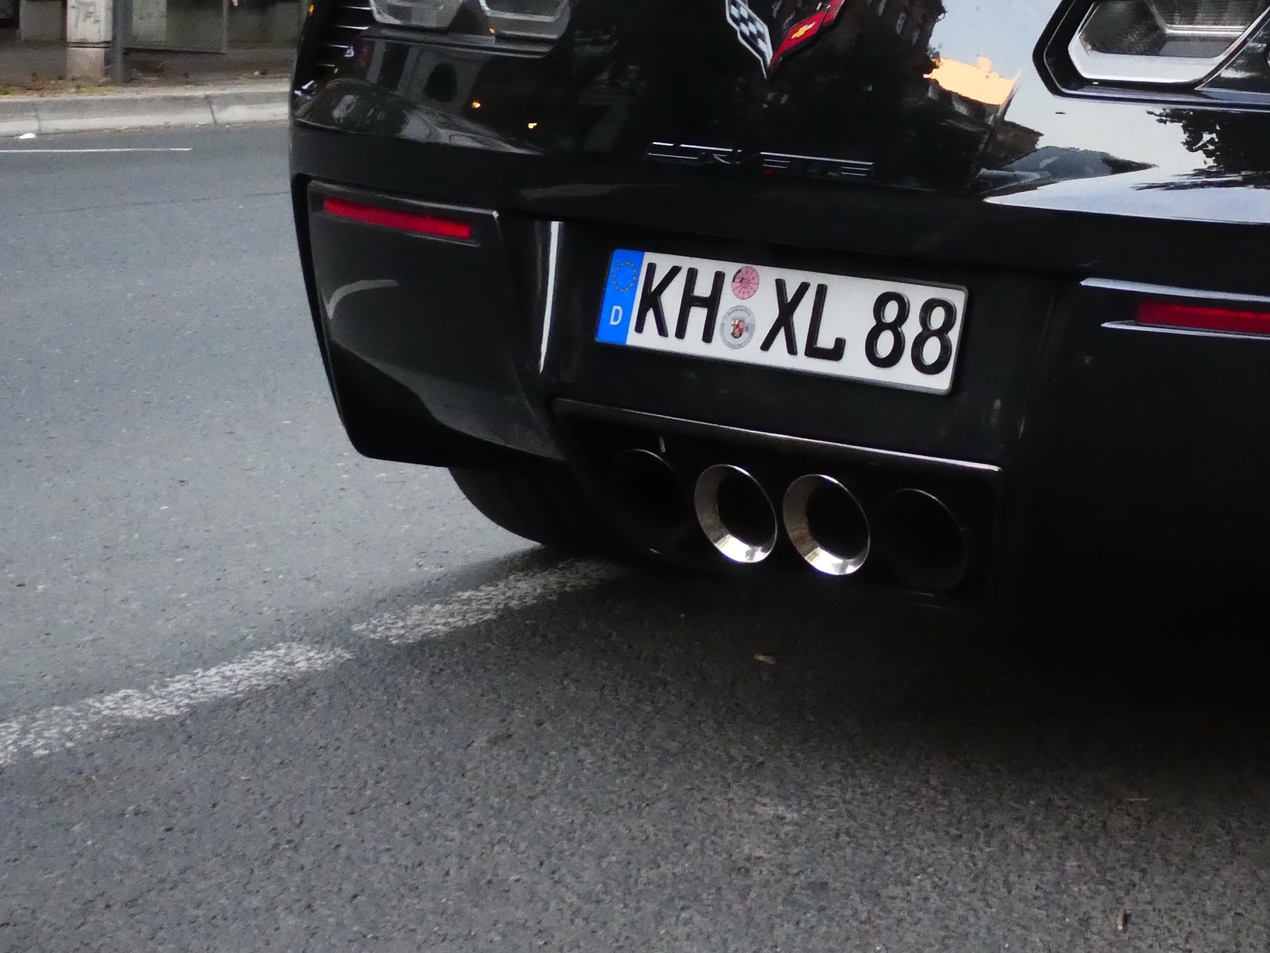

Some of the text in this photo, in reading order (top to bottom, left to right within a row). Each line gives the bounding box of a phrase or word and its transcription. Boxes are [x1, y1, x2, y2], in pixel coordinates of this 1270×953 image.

[609, 305, 623, 326] D
[634, 262, 726, 344] KH
[759, 278, 847, 362] XL
[865, 291, 958, 375] 88
